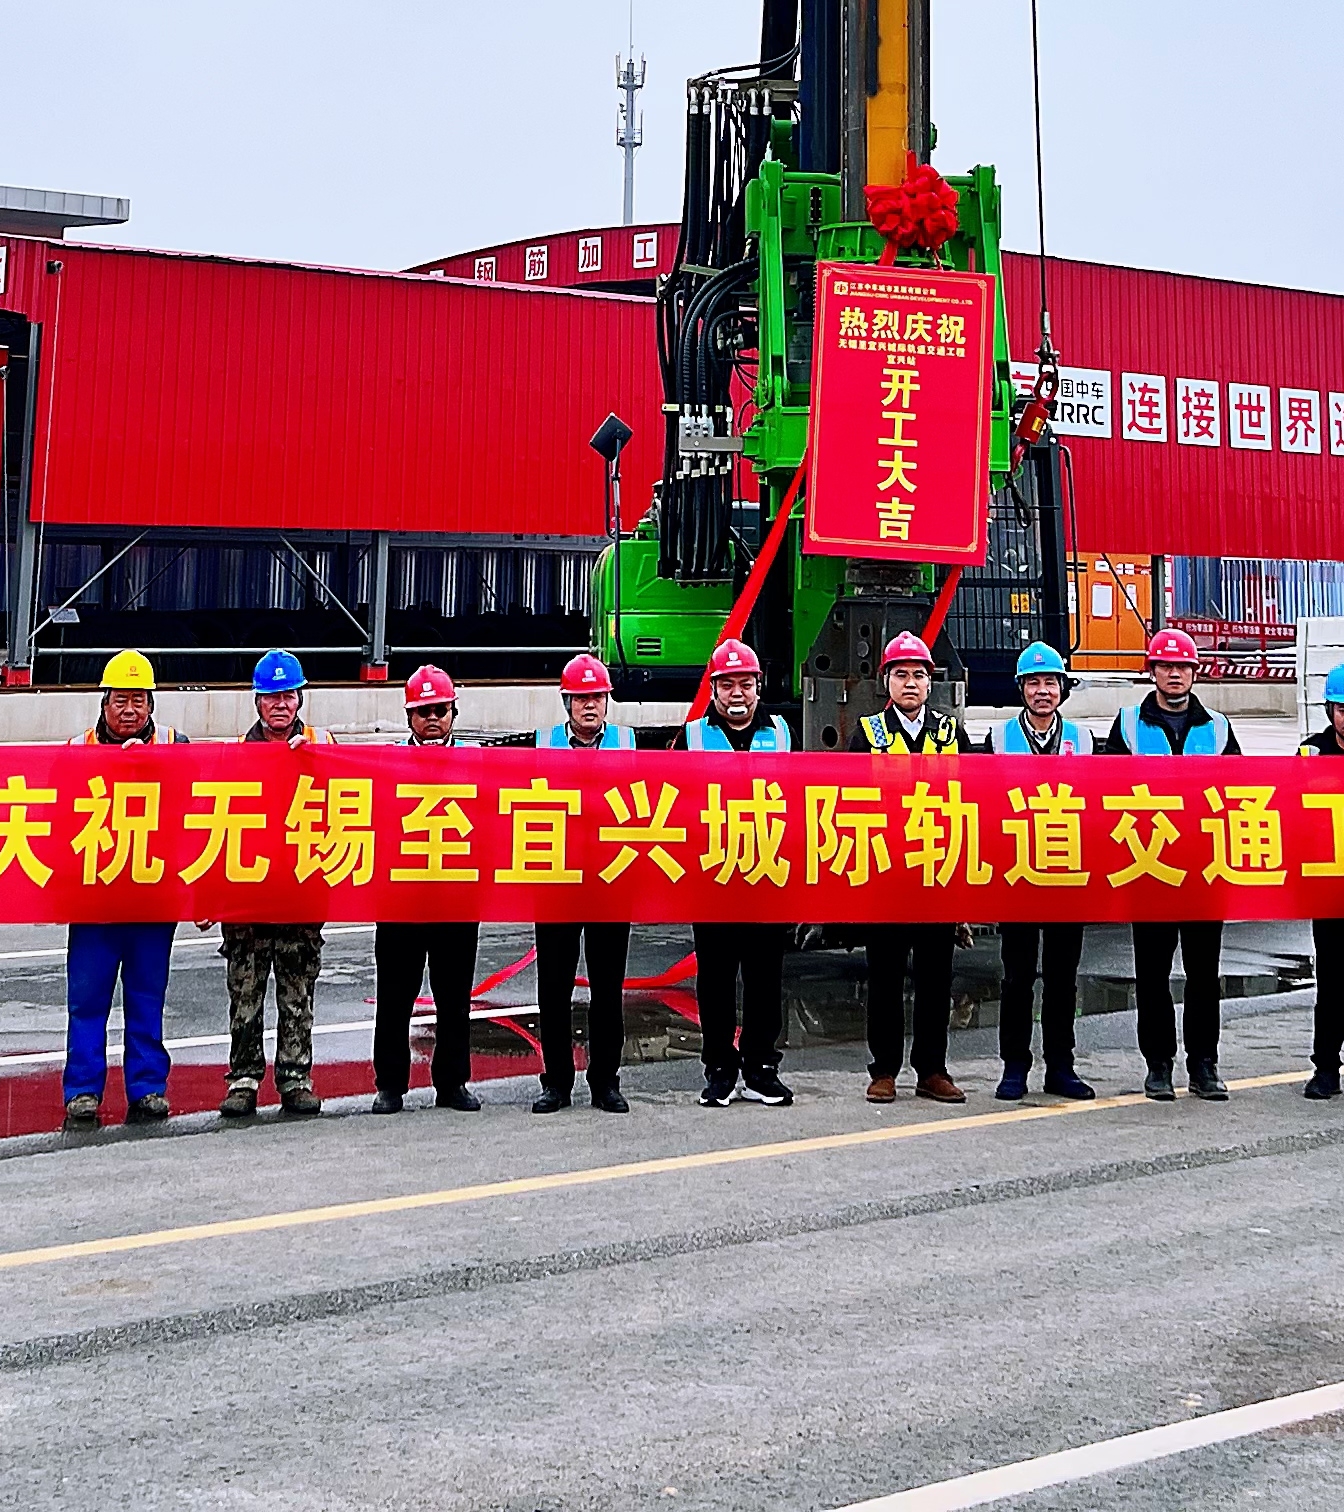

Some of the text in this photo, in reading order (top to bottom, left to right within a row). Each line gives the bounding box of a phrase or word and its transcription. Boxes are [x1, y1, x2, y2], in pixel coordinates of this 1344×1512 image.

[433, 237, 655, 283] 钢筋加工
[839, 306, 966, 345] 热烈庆祝
[886, 354, 916, 366] 宜兴站
[875, 368, 921, 541] 开工大吉
